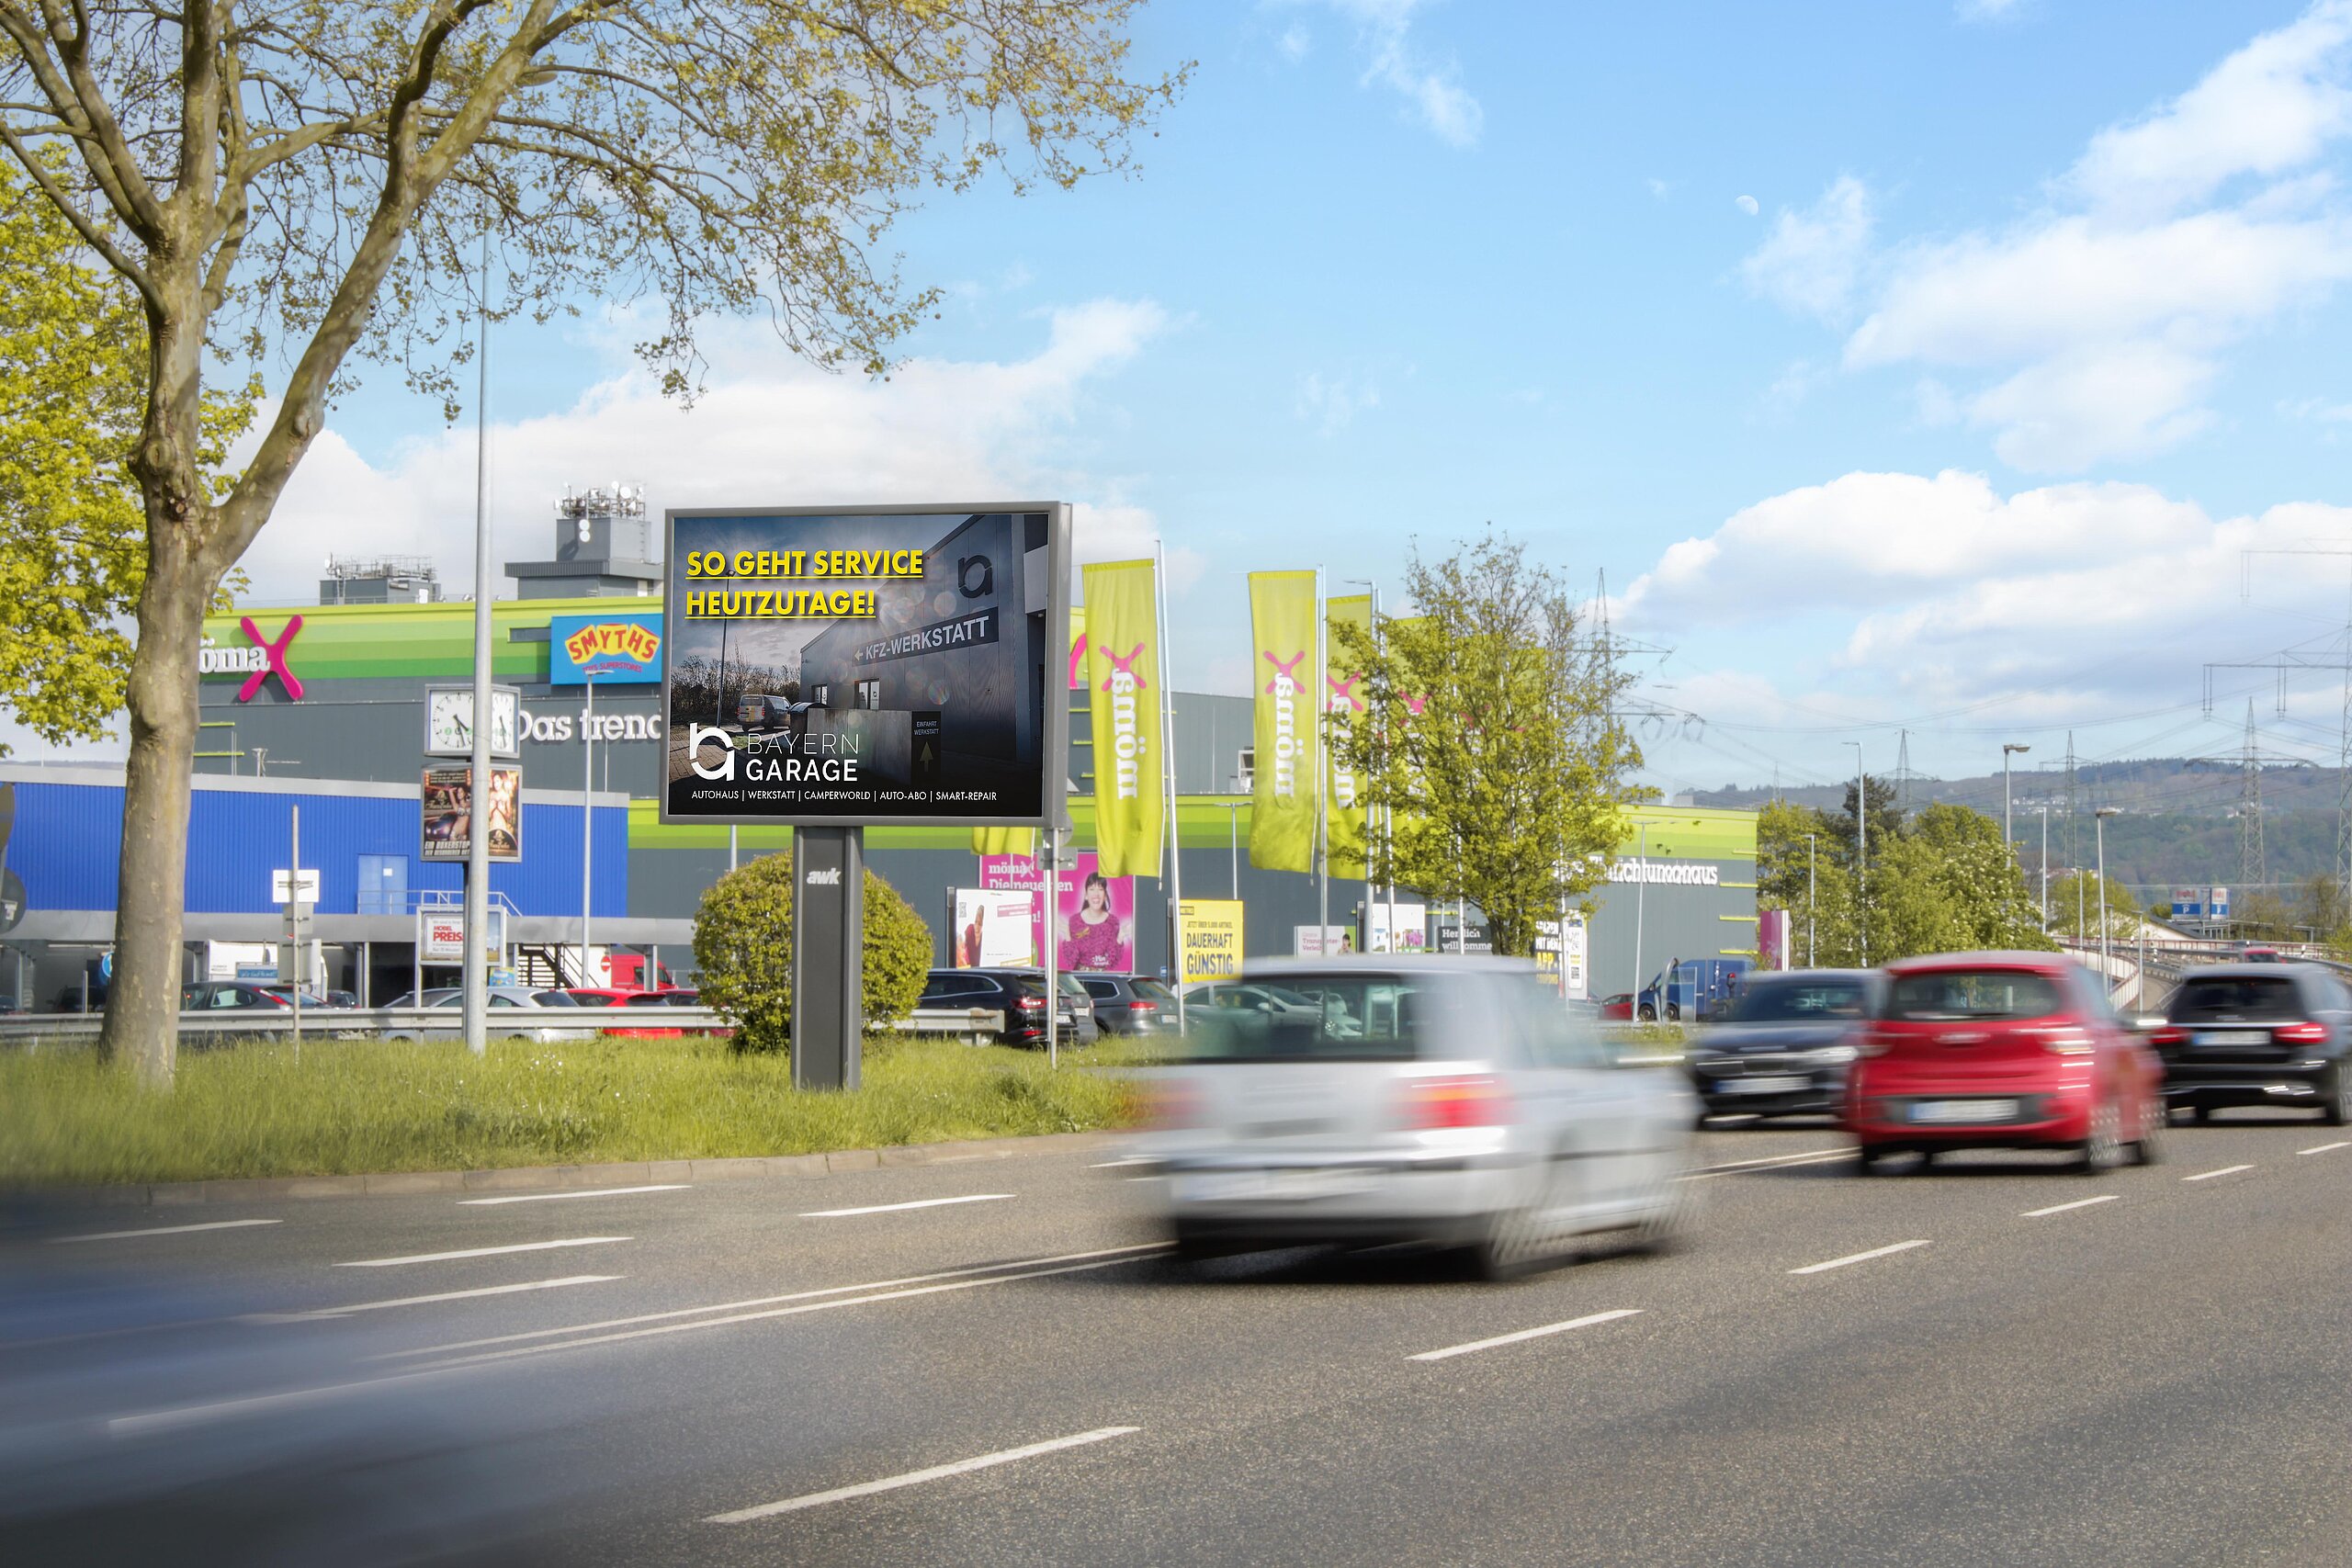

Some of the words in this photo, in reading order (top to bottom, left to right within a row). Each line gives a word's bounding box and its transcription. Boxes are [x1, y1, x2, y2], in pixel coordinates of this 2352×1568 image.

[686, 551, 726, 577] SO
[733, 551, 807, 576] GEHT
[813, 549, 923, 576] SERVICE
[685, 590, 876, 615] HEUTZUTAGE!
[568, 628, 658, 661] SMYTHS
[865, 615, 989, 660] KFZ-WERKSTATT
[519, 710, 572, 741] Das
[914, 728, 939, 736] WERKSTATT
[747, 733, 859, 755] BAYERN
[745, 759, 858, 782] GARAGE
[692, 790, 740, 799] AUTOHAUS
[748, 790, 796, 800] WERKSTATT
[804, 790, 871, 800] CAMPERWORLD
[879, 791, 927, 800] AUTO-ABO
[935, 791, 997, 801] SMART-REPAIR
[1186, 932, 1233, 948] DAUERHAFT
[1442, 928, 1481, 939] Herlich
[1442, 942, 1493, 951] willomme
[1187, 951, 1233, 975] GÜNSTIG
